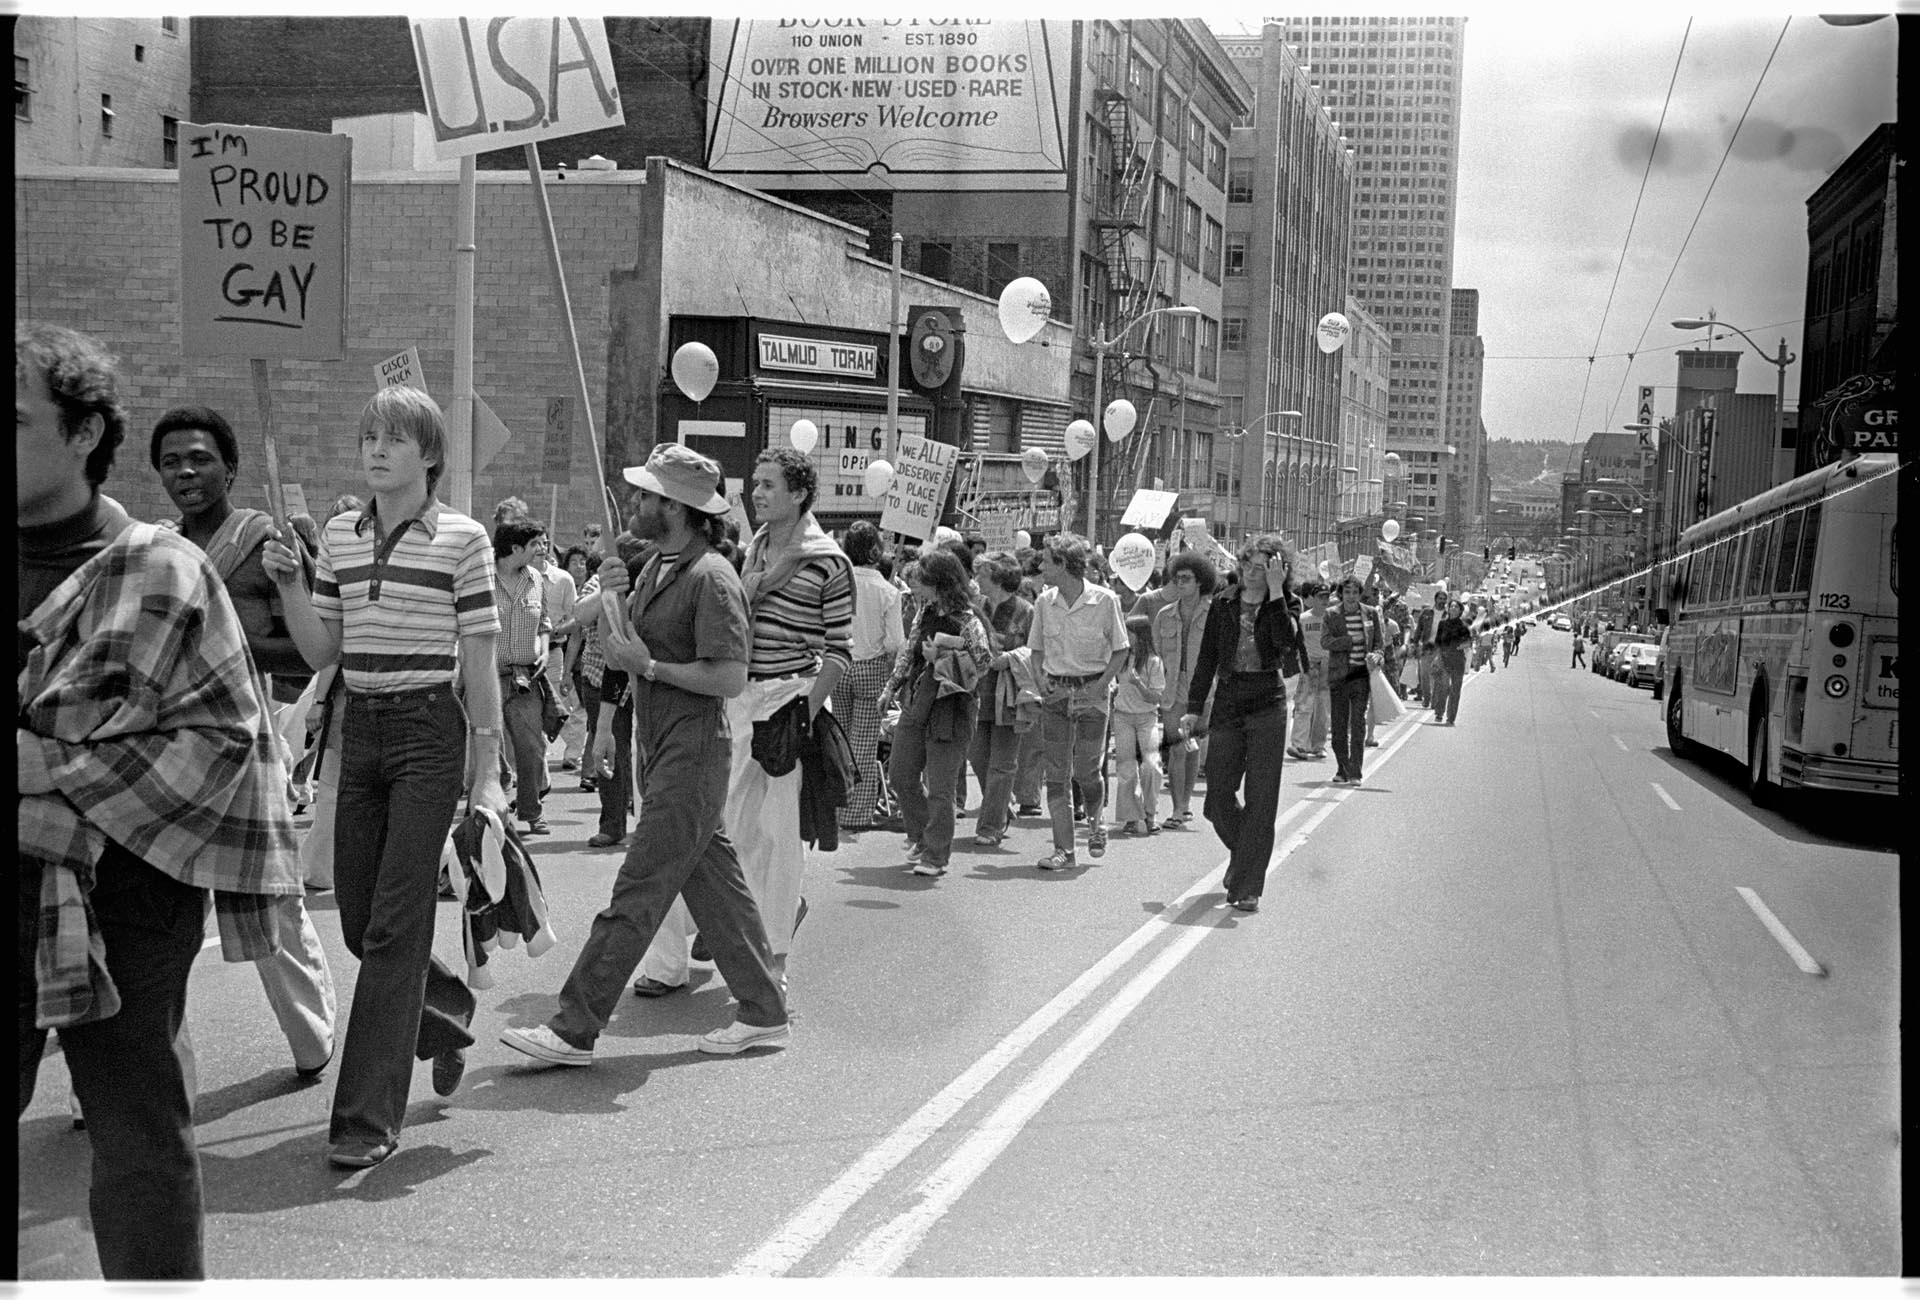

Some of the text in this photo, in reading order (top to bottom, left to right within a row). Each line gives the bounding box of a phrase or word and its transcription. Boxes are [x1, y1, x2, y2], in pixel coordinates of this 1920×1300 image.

[792, 35, 813, 47] 110
[819, 34, 863, 47] UNION
[939, 32, 978, 46] 1890
[751, 54, 1028, 76] OVER ONE MILLION BOOKS
[752, 79, 1023, 99] IN STOCK NEW USED RARE
[761, 104, 998, 129] Browsers Welcome
[210, 164, 329, 207] PROUD
[203, 218, 316, 249] TO BE
[221, 262, 317, 321] GAY
[762, 340, 875, 372] TALMUD TORAH
[902, 444, 918, 460] WE
[917, 441, 943, 467] ALL
[896, 462, 942, 485] DESERVE
[890, 479, 936, 503] A PLACE
[887, 494, 901, 510] TO
[906, 500, 930, 519] LIVE
[1820, 593, 1851, 610] 1123
